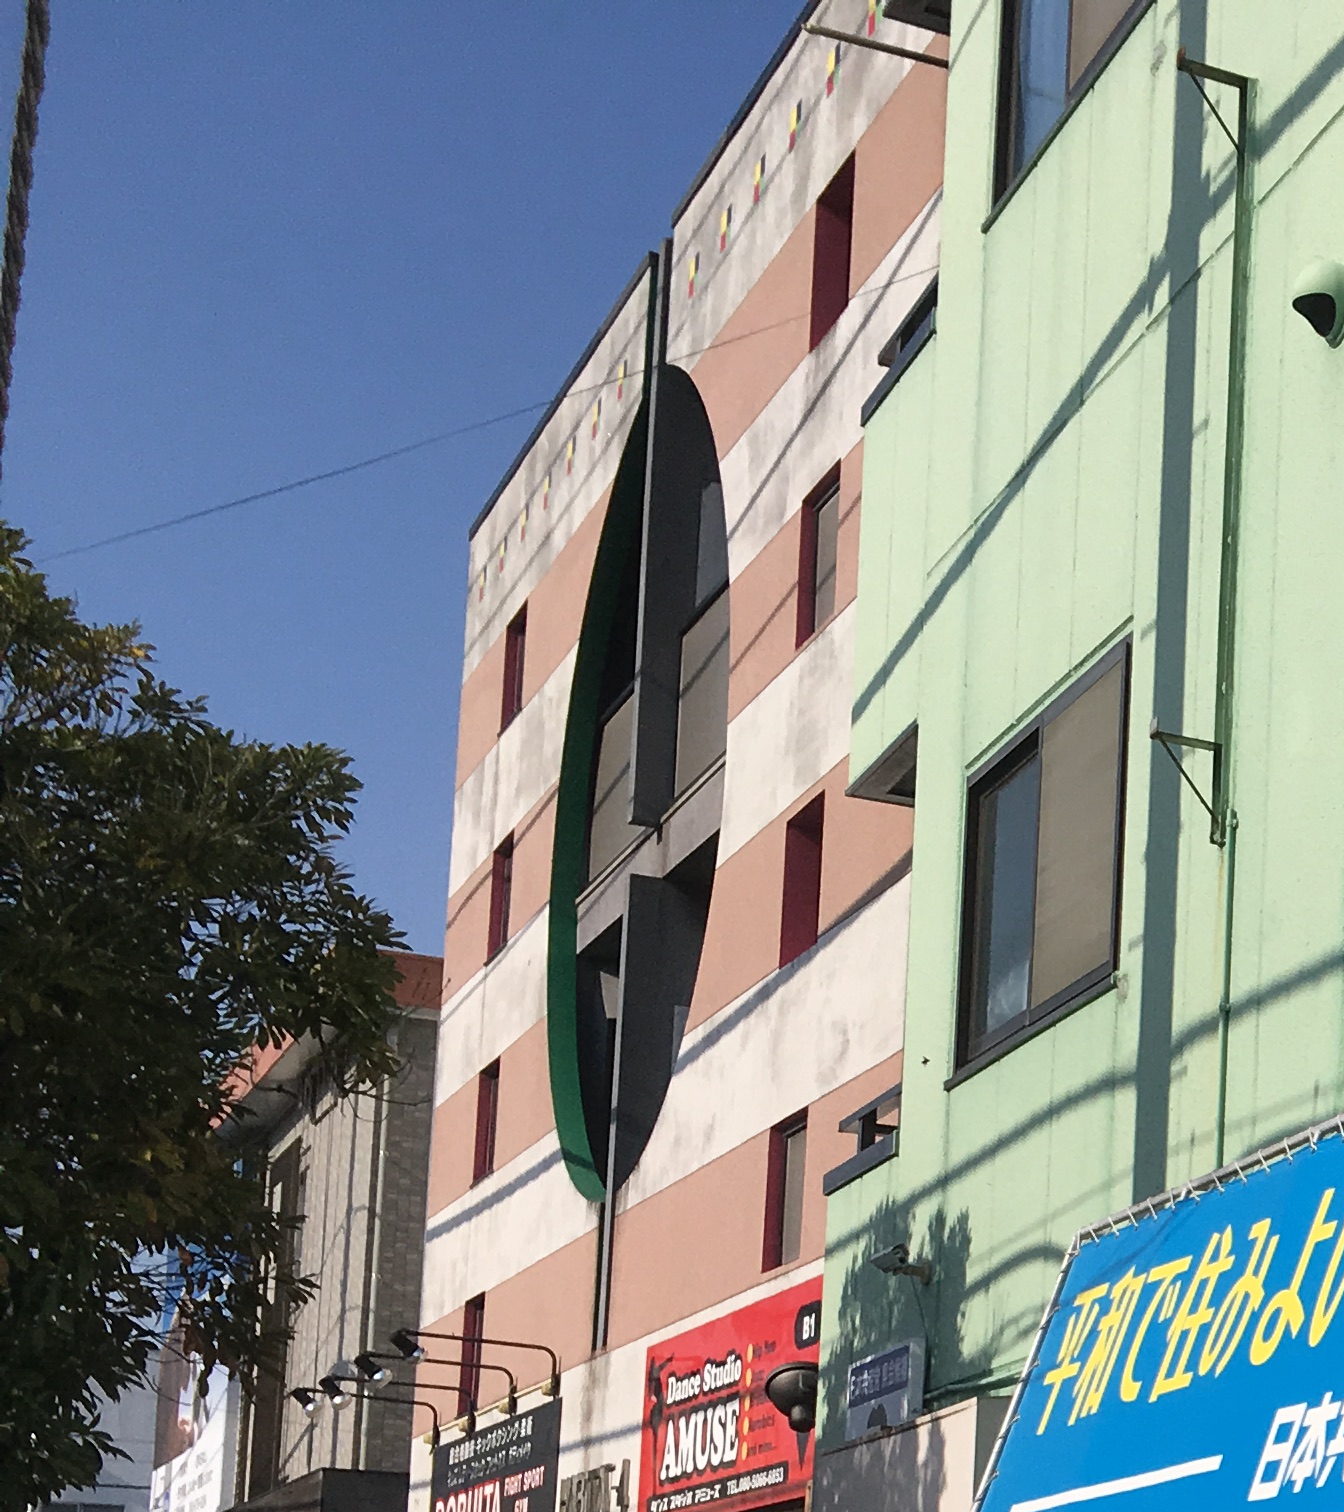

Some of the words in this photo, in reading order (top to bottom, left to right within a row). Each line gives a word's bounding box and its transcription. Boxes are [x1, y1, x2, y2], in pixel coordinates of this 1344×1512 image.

[802, 1312, 816, 1340] B1
[666, 1373, 701, 1405] Dance
[702, 1353, 742, 1393] Studio
[659, 1397, 741, 1480] AMUSE
[522, 1465, 545, 1492] SPORT
